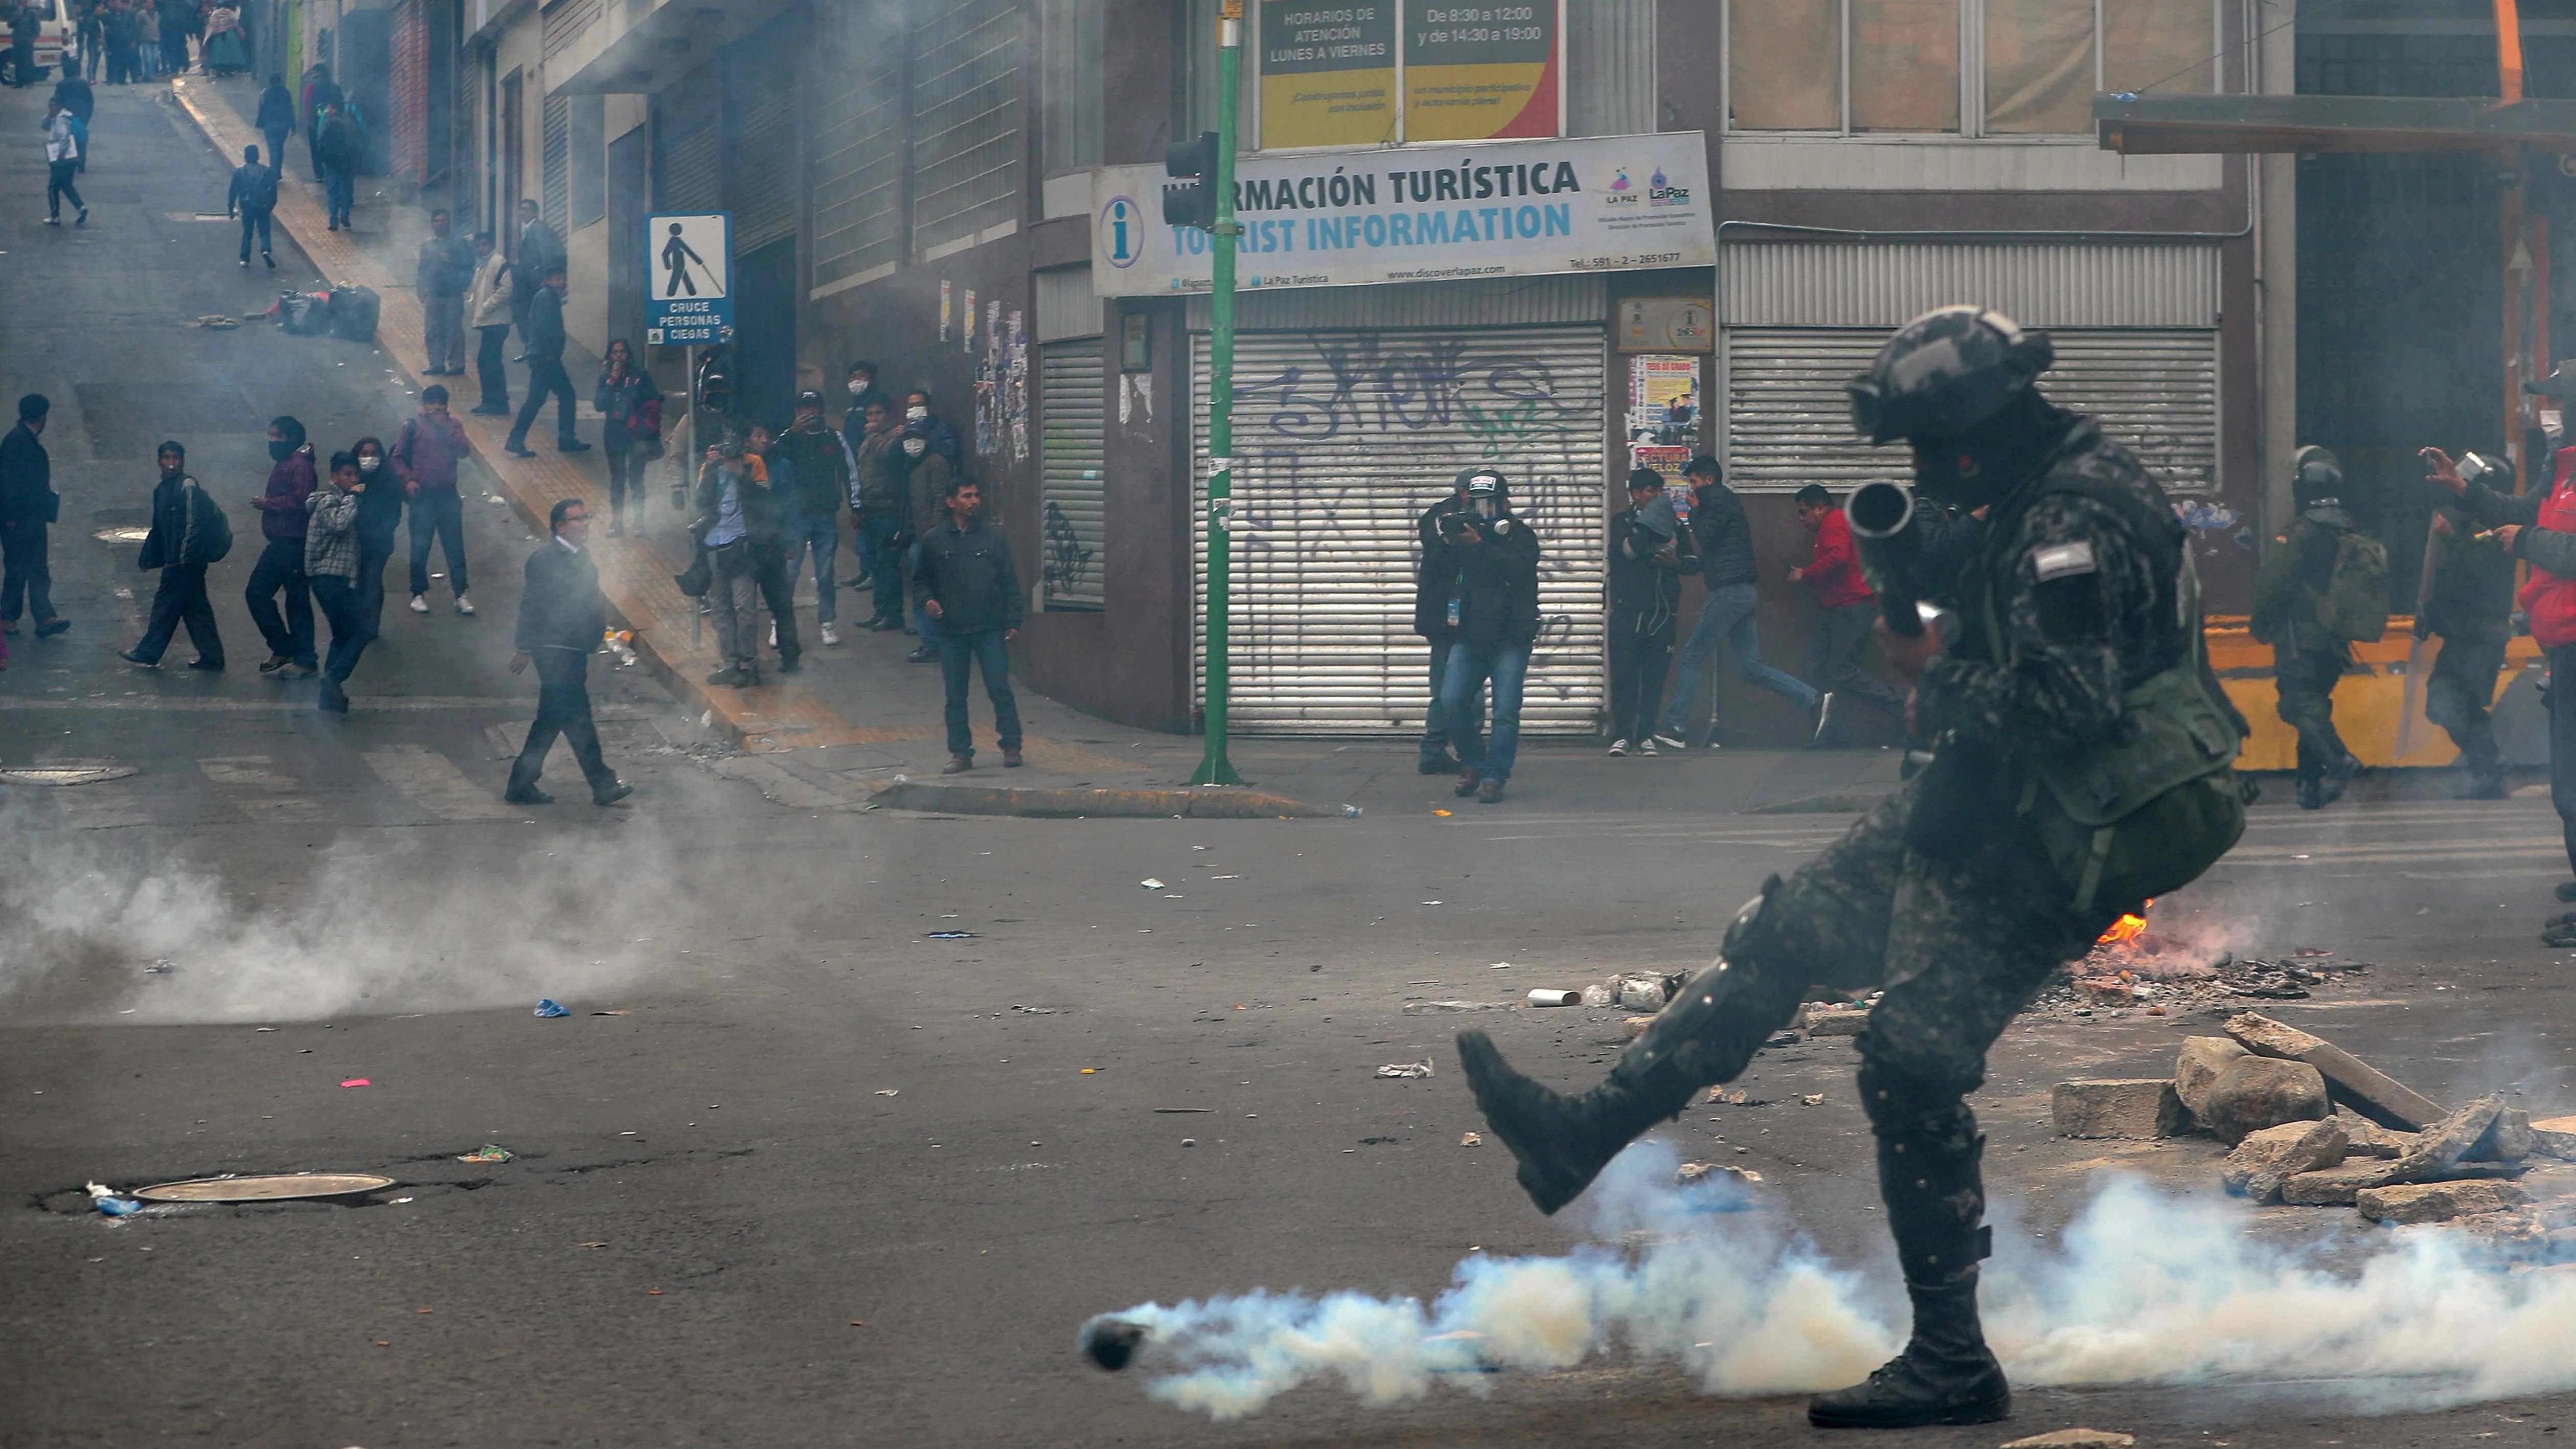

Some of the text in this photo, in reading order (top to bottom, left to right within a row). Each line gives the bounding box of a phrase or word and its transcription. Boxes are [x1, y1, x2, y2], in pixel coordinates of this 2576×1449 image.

[1284, 8, 1375, 26] HORARIOS DE
[1427, 7, 1533, 22] De 8:30 a 12:00
[1294, 24, 1361, 42] ATENCIÓN
[1417, 27, 1542, 47] y de 14:30 a 19:00
[1270, 43, 1386, 62] LUNES A VIERNES
[1388, 158, 1581, 203] TURÍSTICA
[1607, 195, 1638, 203] LA PAZ
[1308, 202, 1570, 251] INFORMATION
[1592, 258, 1609, 266] 591
[1639, 253, 1680, 263] 2651677
[1387, 265, 1505, 280] www.discoverlapaz.com
[1264, 276, 1274, 285] La
[1276, 276, 1290, 285] Paz
[670, 302, 710, 313] CRUCE
[659, 315, 721, 327] PERSONAS
[671, 329, 710, 339] CIEGAS
[1637, 454, 1688, 463] LECTURA
